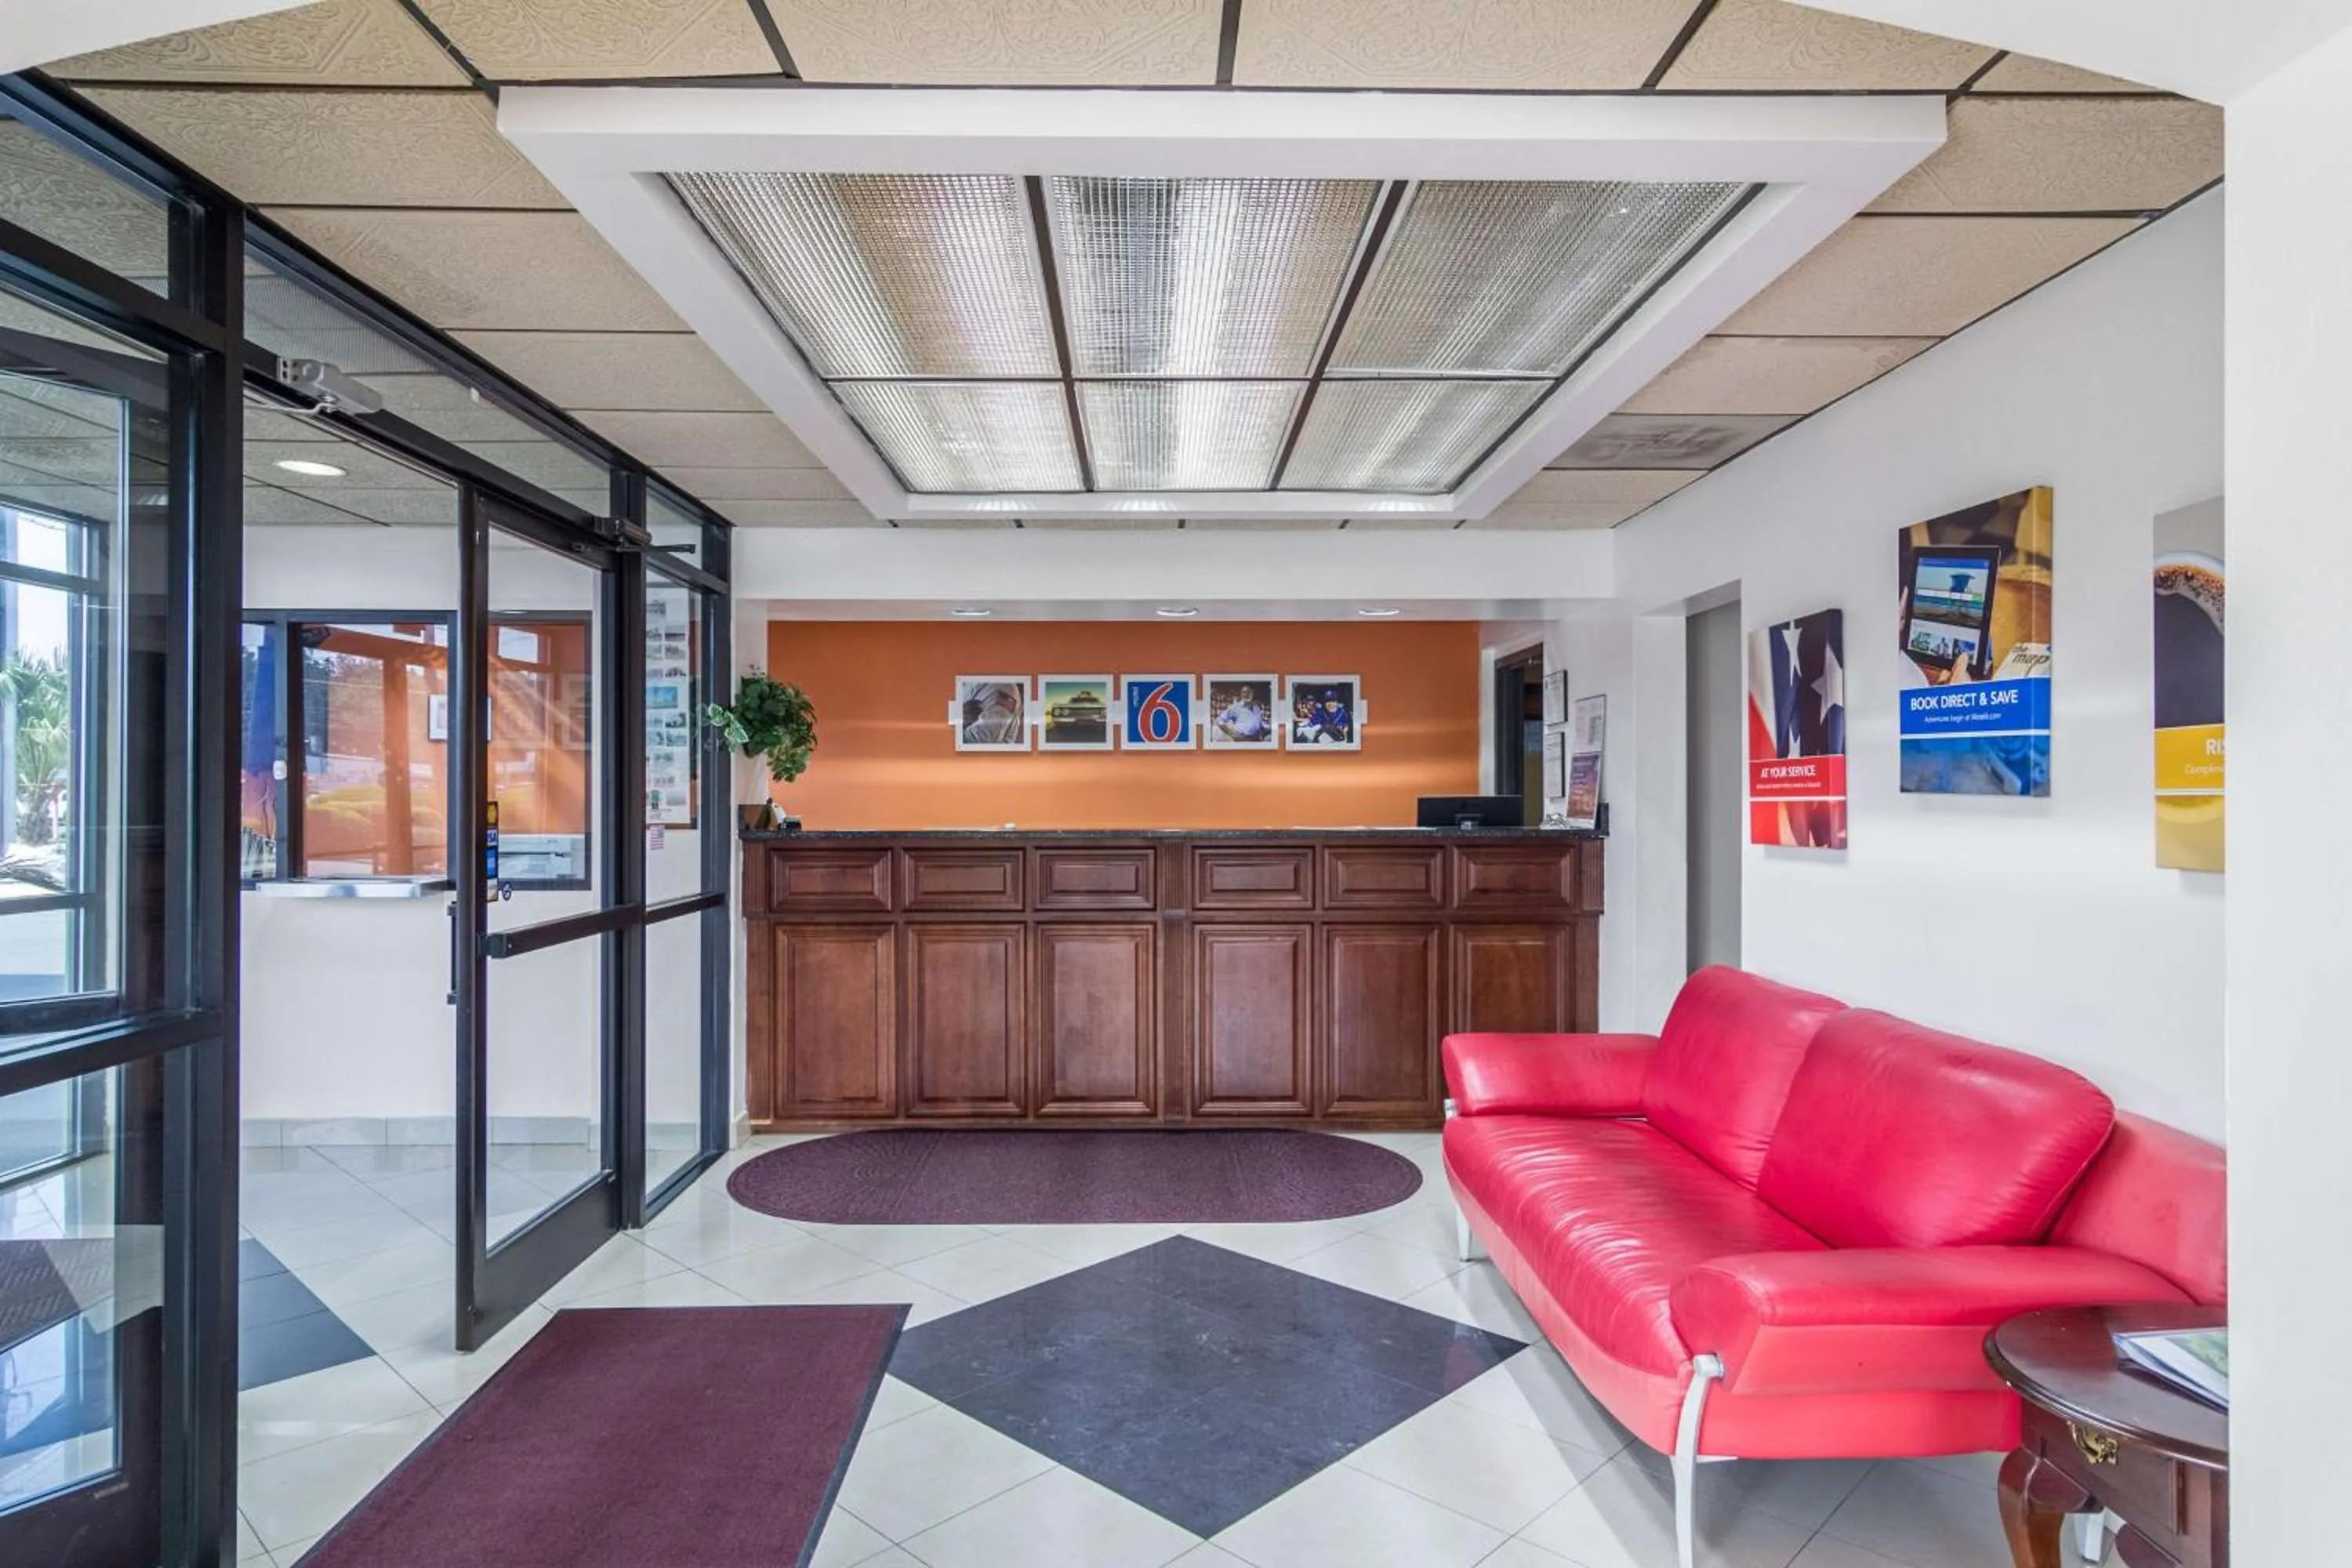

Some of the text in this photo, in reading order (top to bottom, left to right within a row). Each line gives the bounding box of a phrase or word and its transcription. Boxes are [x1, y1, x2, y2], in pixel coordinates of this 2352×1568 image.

[1911, 689, 2019, 711] BOOK DIRECT & SAVE
[1138, 681, 1182, 743] 6
[1760, 764, 1816, 779] AT YOUR SERVICE
